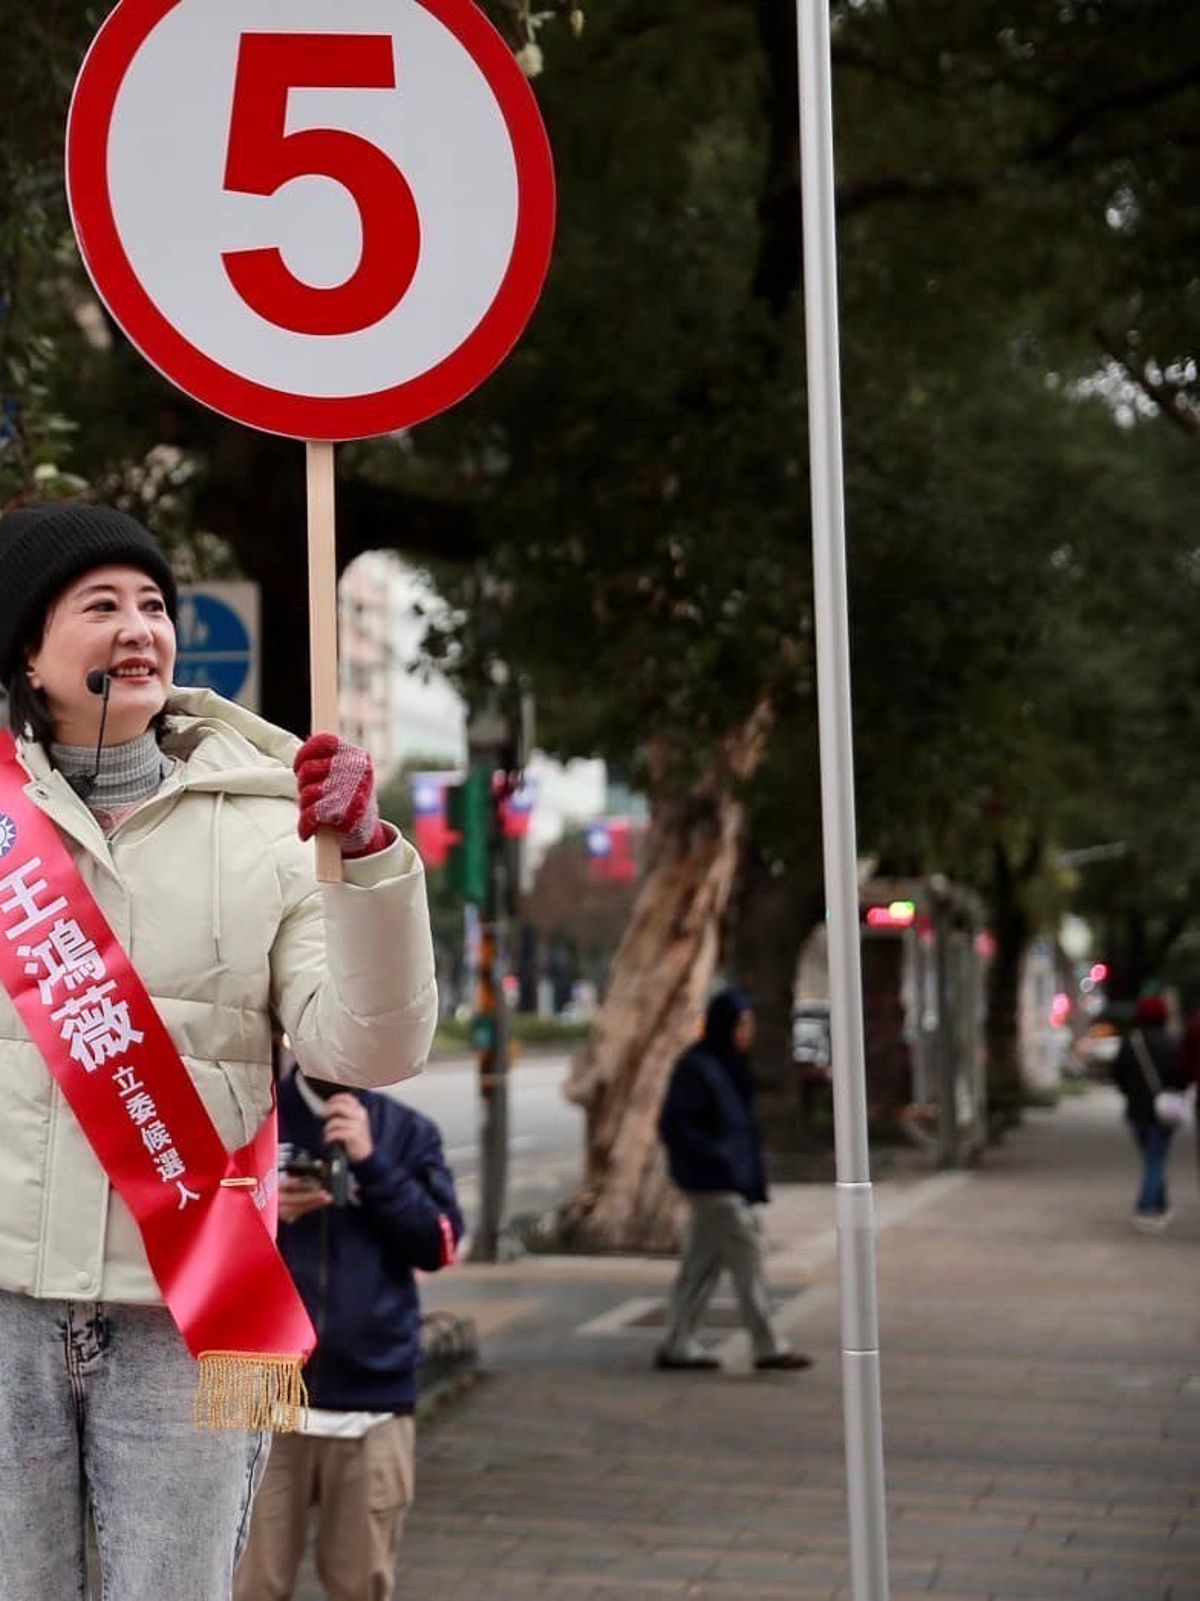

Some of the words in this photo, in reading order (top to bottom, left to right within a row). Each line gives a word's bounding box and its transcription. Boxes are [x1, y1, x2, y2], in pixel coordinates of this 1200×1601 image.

[222, 33, 420, 336] 5
[112, 1065, 201, 1211] 立委候選人
